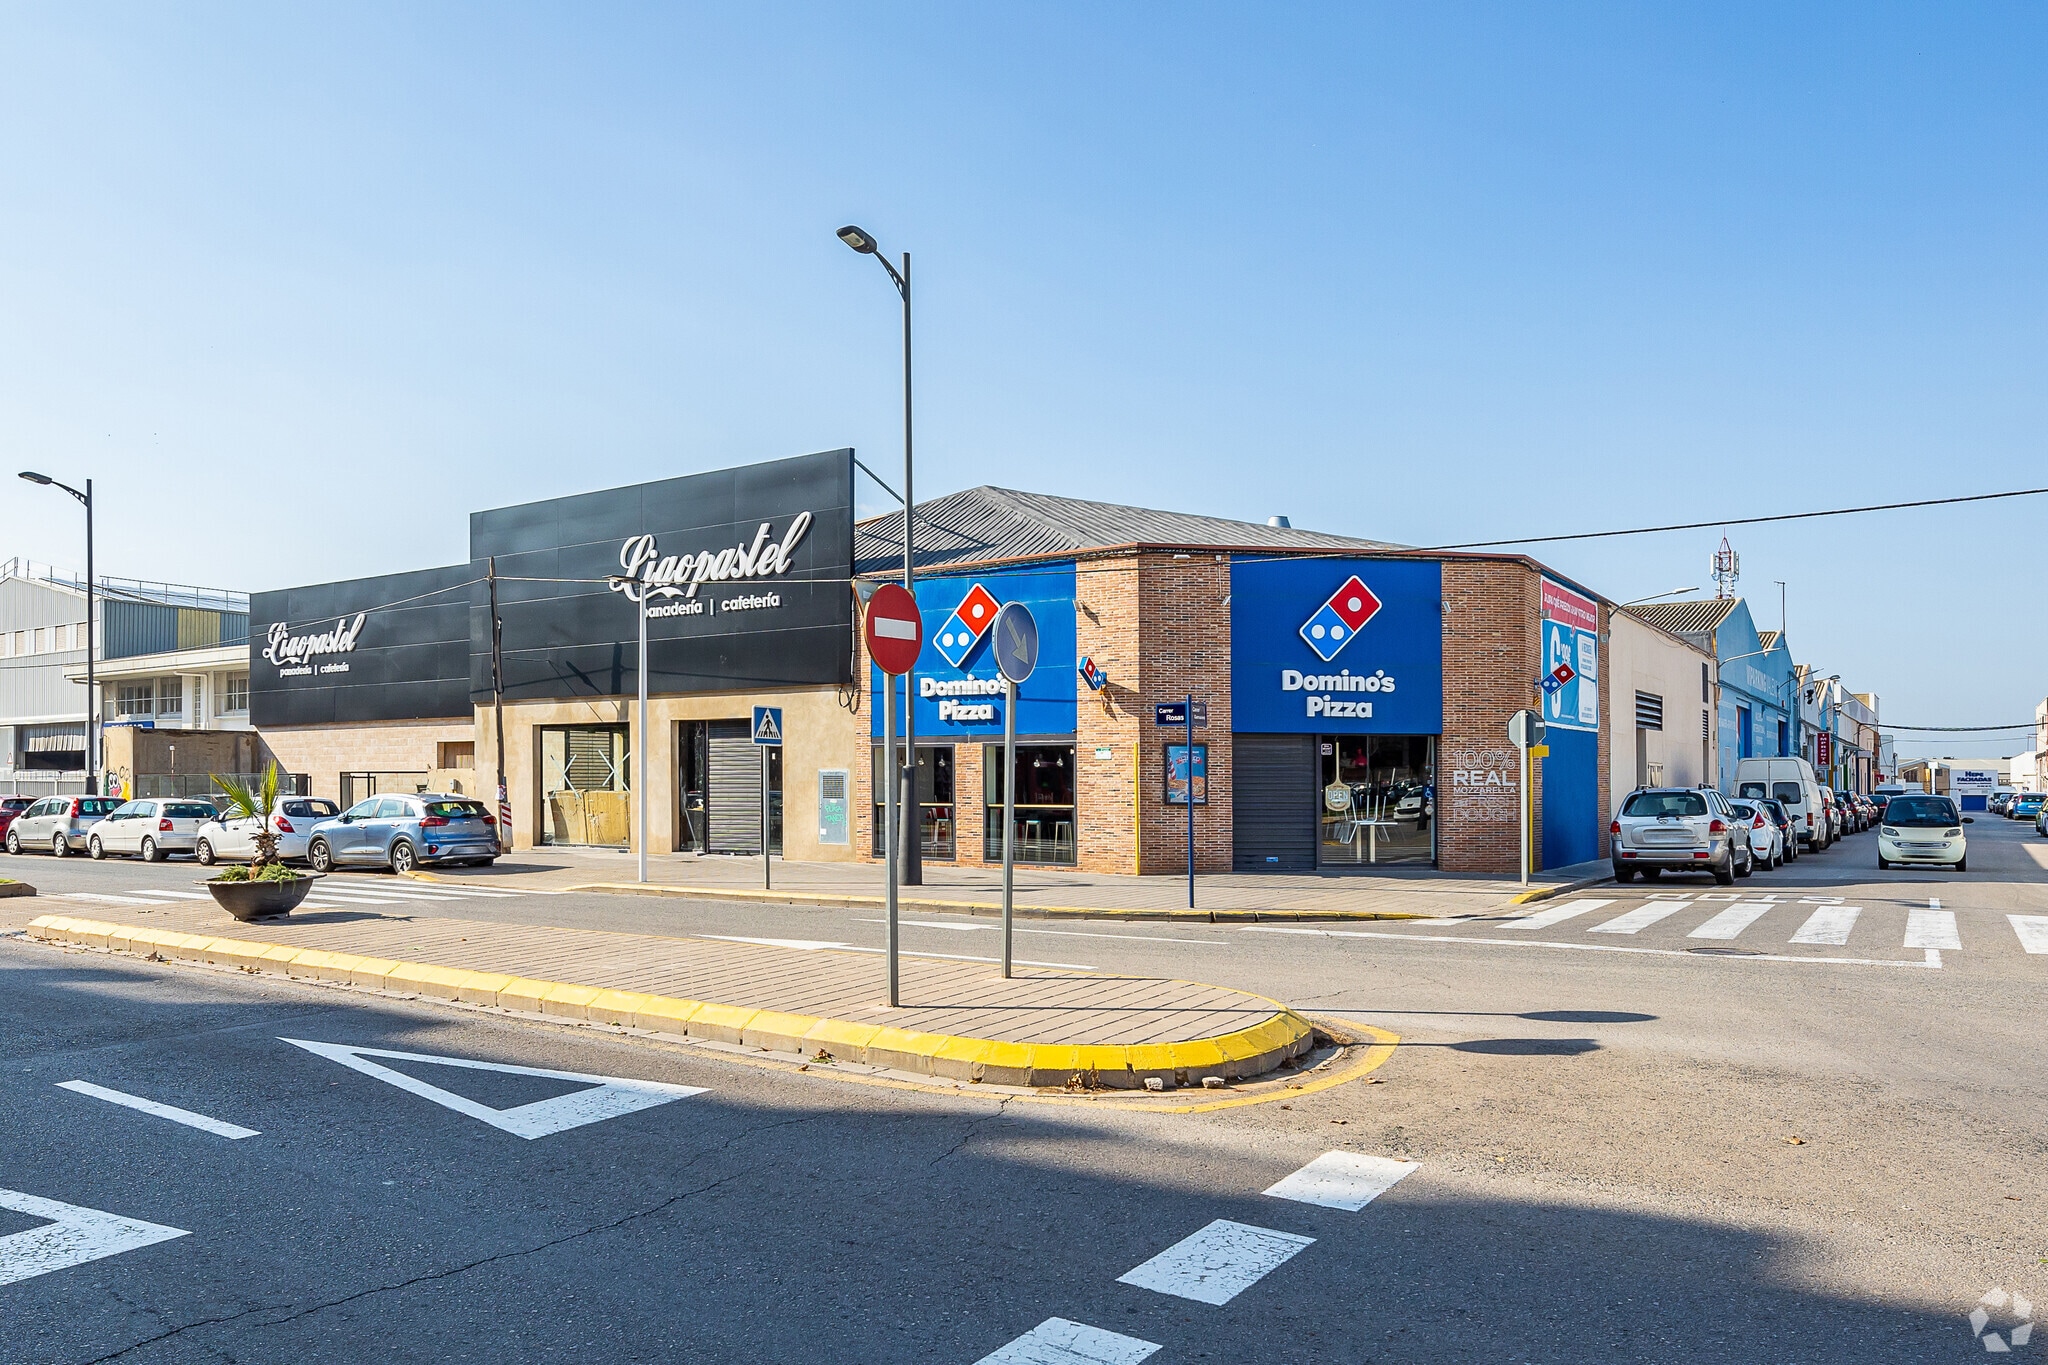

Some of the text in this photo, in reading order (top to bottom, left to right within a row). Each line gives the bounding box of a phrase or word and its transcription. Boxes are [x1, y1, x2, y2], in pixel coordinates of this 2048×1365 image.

[609, 511, 812, 602] Liaopastel
[646, 591, 780, 619] anadería cafetería
[262, 613, 365, 666] Liaopastel
[280, 661, 350, 678] panadería cafetería
[1281, 669, 1396, 693] Domino's
[939, 699, 994, 720] Pizza
[1306, 694, 1373, 718] Pizza
[1453, 750, 1515, 769] 100%
[1453, 770, 1516, 786] REAL
[1328, 790, 1349, 801] OPEN
